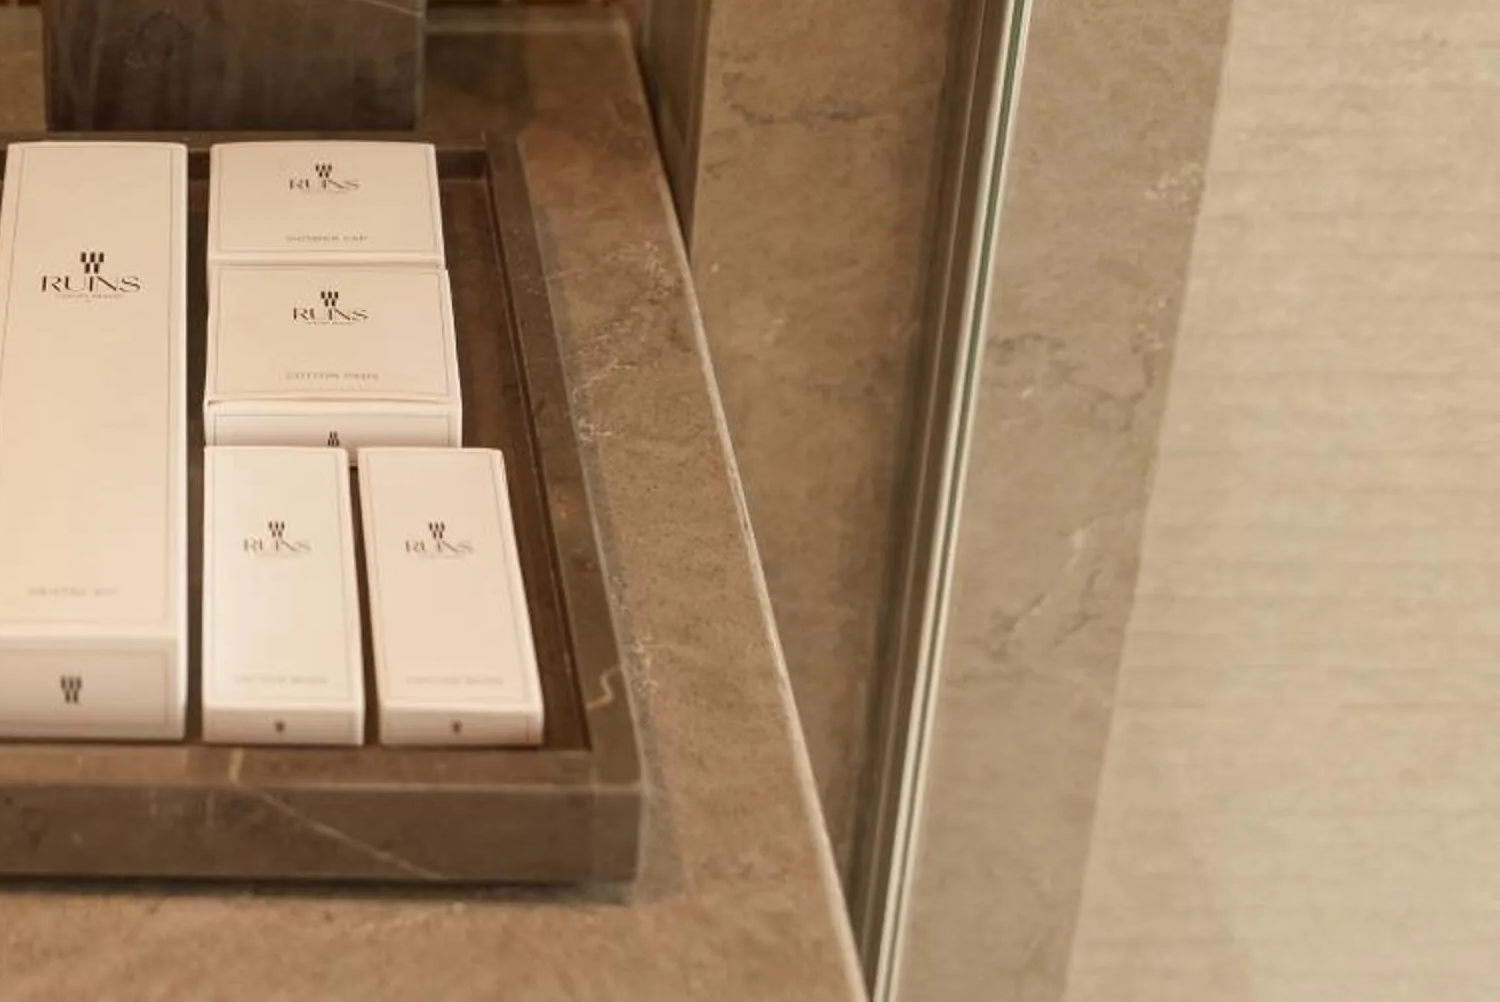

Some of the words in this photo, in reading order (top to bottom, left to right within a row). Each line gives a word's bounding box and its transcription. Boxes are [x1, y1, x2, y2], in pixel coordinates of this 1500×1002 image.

[288, 179, 360, 191] RUINS
[41, 275, 141, 293] RUINS
[292, 307, 369, 321] RUINS
